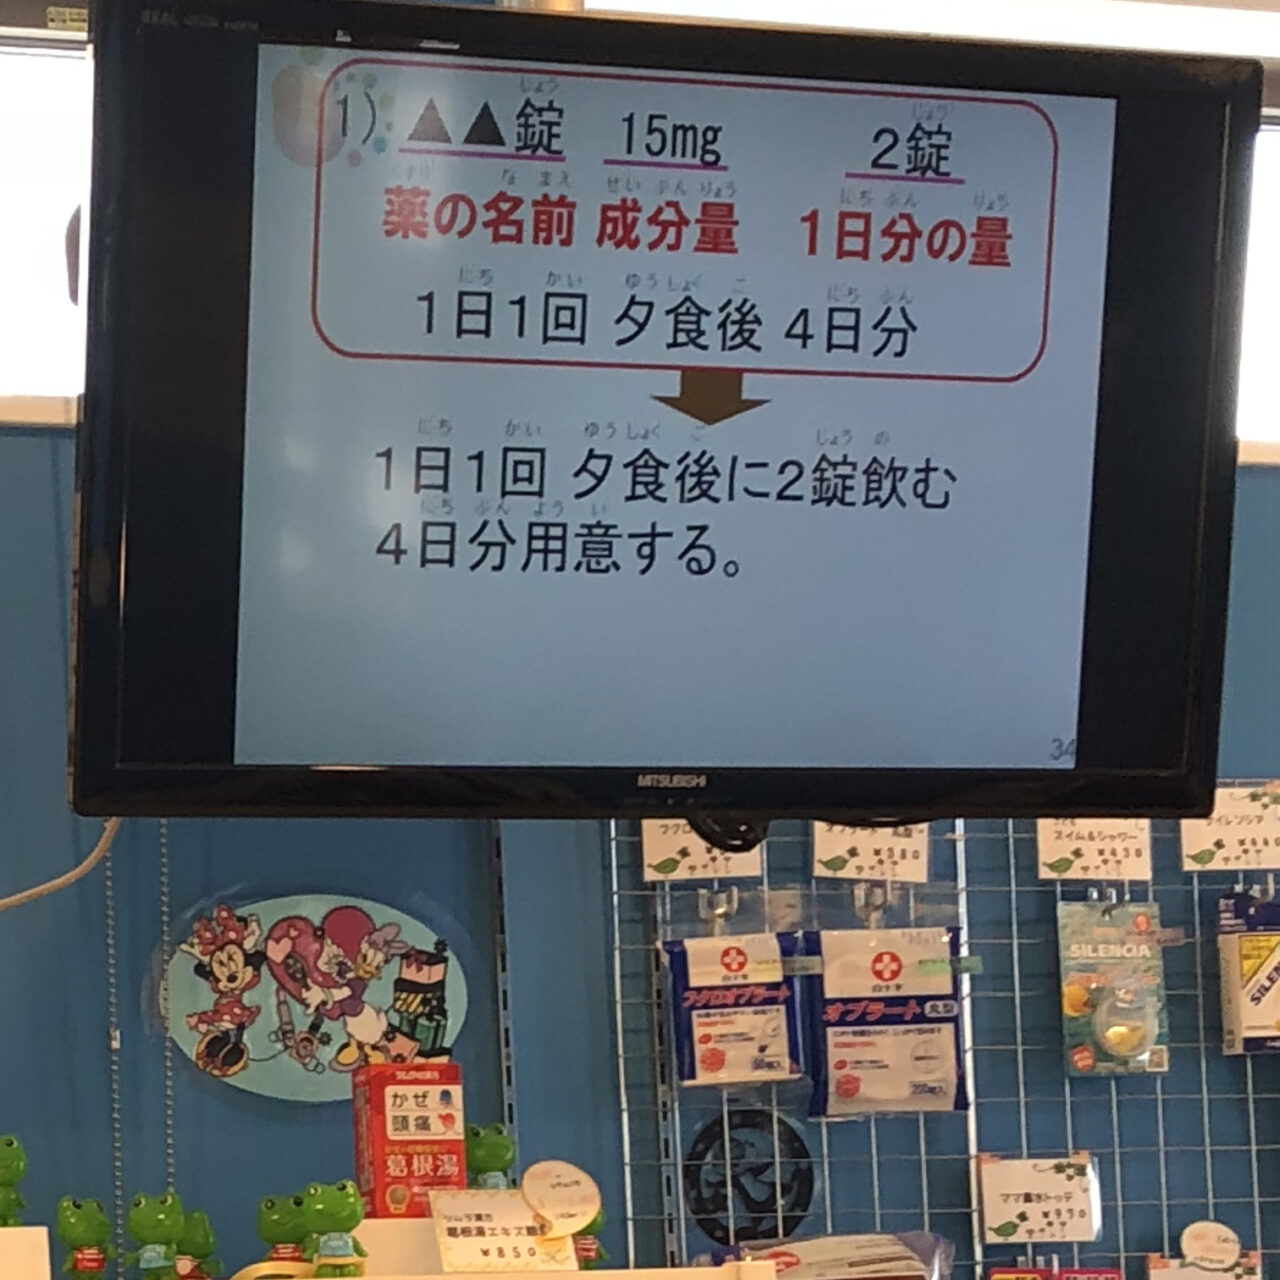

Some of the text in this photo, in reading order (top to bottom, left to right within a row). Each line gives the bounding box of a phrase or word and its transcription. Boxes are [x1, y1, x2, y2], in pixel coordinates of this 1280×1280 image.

[620, 111, 724, 167] 15mg
[870, 121, 954, 178] 2錠
[381, 184, 1014, 268] 薬の名前 成分量 1日分の量
[416, 290, 919, 359] 1日1回 夕食後 4日分
[374, 445, 959, 510] 1日1回 夕食後に2錠飲む
[375, 519, 741, 578] 4日分用意する。
[636, 773, 708, 789] MITSUBISHI
[821, 998, 923, 1023] オブラート
[391, 1090, 431, 1109] かぜ
[391, 1114, 432, 1132] 頭痛
[386, 1153, 459, 1178] 葛根湯
